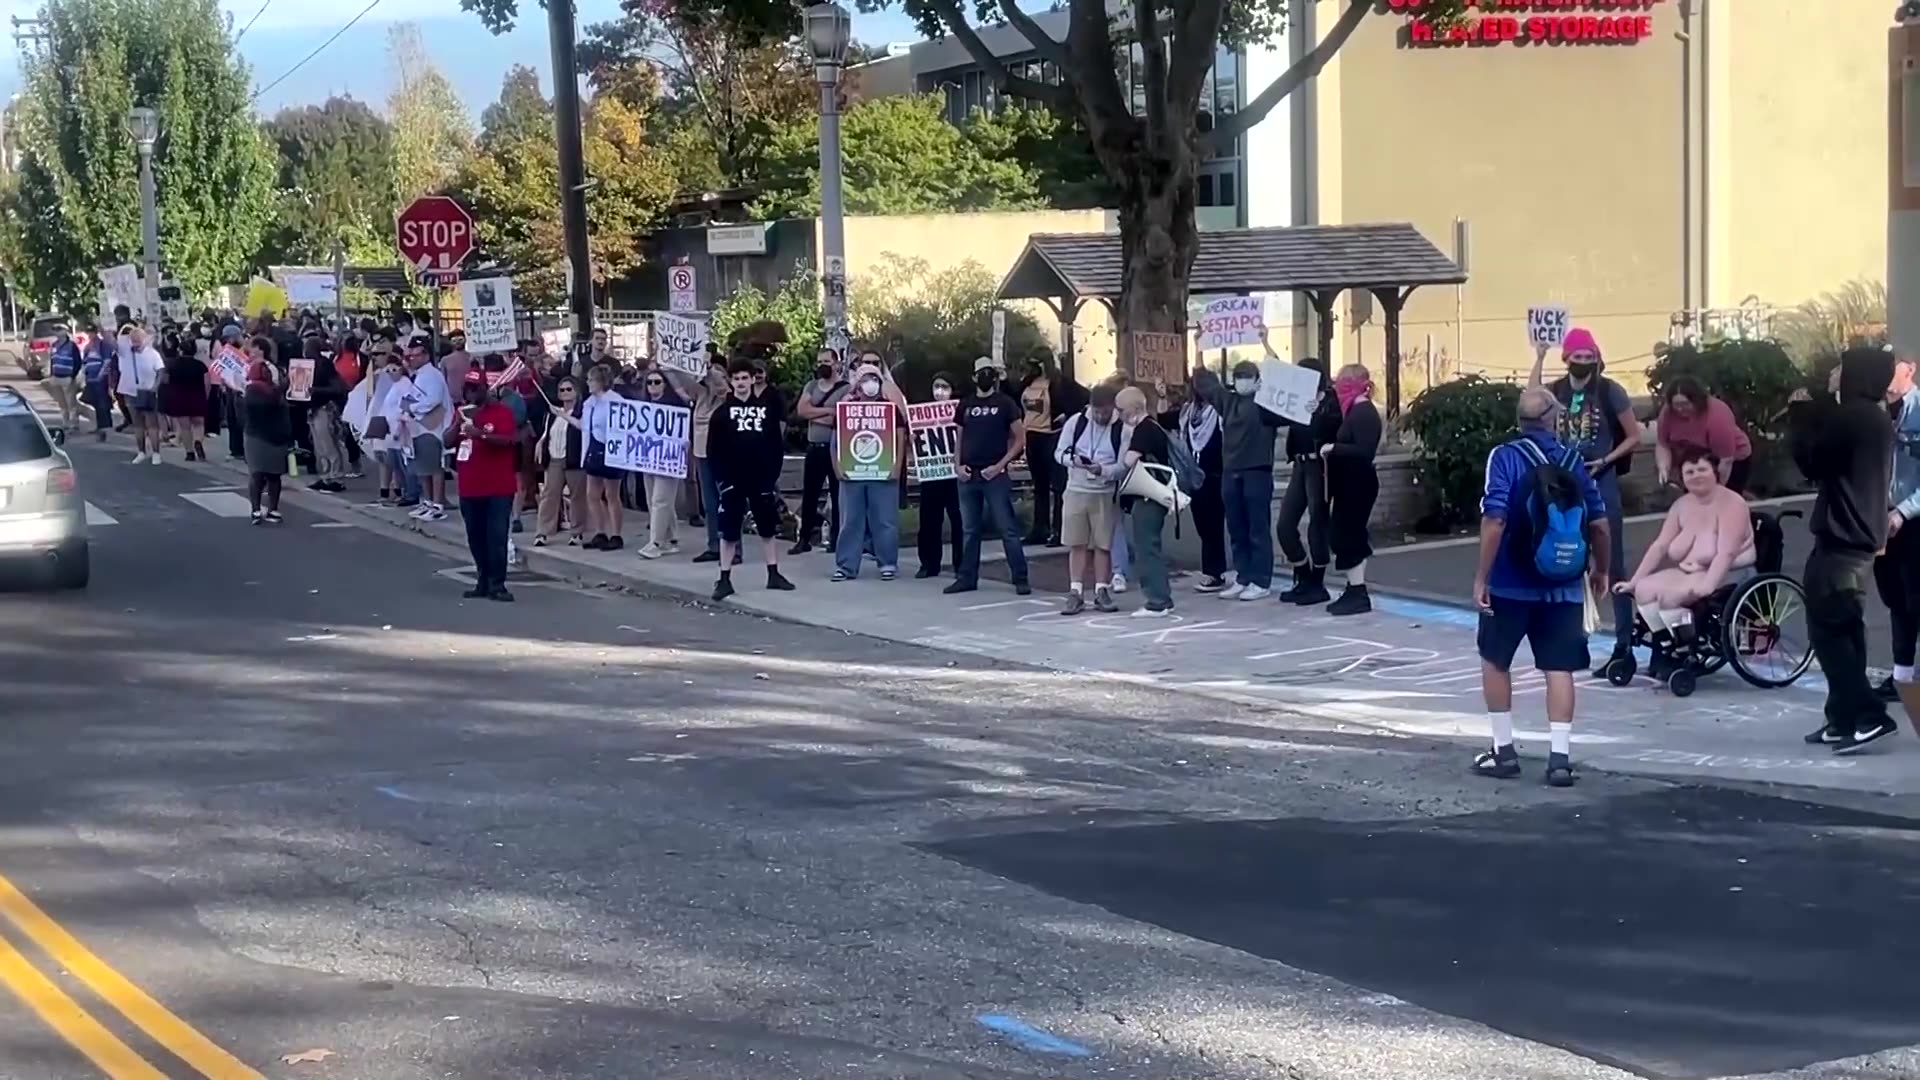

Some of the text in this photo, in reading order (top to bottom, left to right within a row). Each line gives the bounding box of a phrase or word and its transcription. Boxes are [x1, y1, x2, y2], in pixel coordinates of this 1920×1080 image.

[1527, 15, 1652, 40] STORAGE
[403, 220, 466, 247] STOP
[1528, 309, 1565, 325] FUCK
[1212, 331, 1245, 347] OUT
[1534, 328, 1562, 344] ICE!
[730, 406, 766, 419] FUCK
[846, 405, 886, 417] ICE OUT
[609, 401, 688, 438] FEDS OUT
[737, 418, 763, 431] ICE
[847, 418, 860, 429] OF
[608, 440, 622, 455] OF
